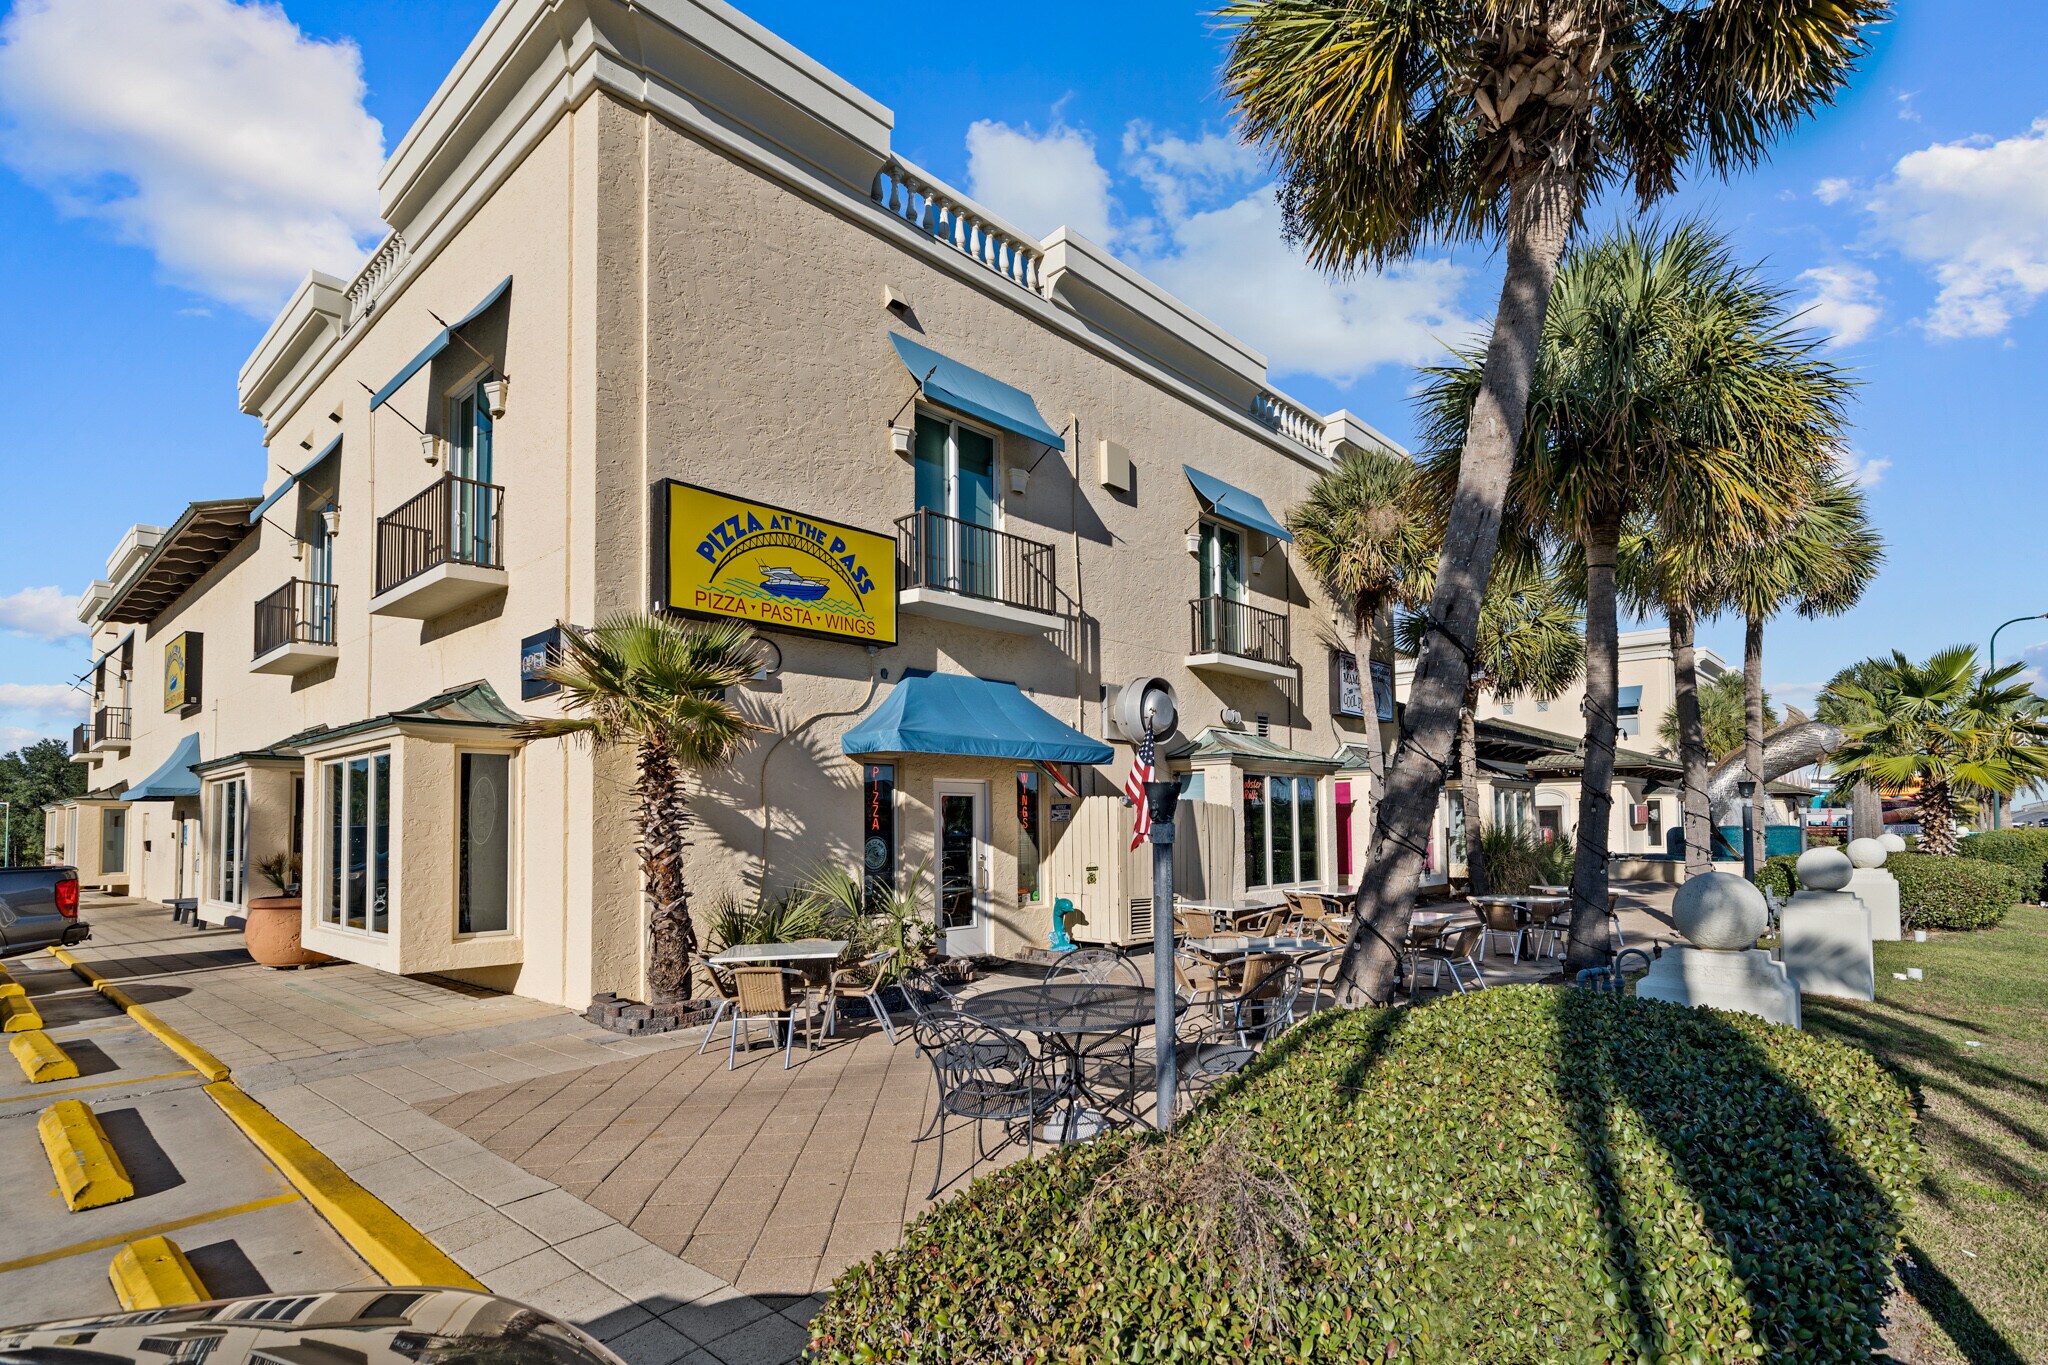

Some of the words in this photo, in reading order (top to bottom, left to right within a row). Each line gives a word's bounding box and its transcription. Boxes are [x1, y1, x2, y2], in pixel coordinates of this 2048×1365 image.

[696, 511, 764, 564] PIZZA
[770, 514, 792, 532] AT
[796, 520, 828, 546] THE
[829, 536, 875, 595] PASS
[695, 590, 747, 614] PIZZA
[761, 602, 813, 626] PASTA
[825, 613, 876, 636] WINGS
[522, 651, 547, 673] OPEN
[872, 766, 880, 830] PIZZA
[1020, 772, 1029, 829] WINGS
[1244, 778, 1261, 789] obster
